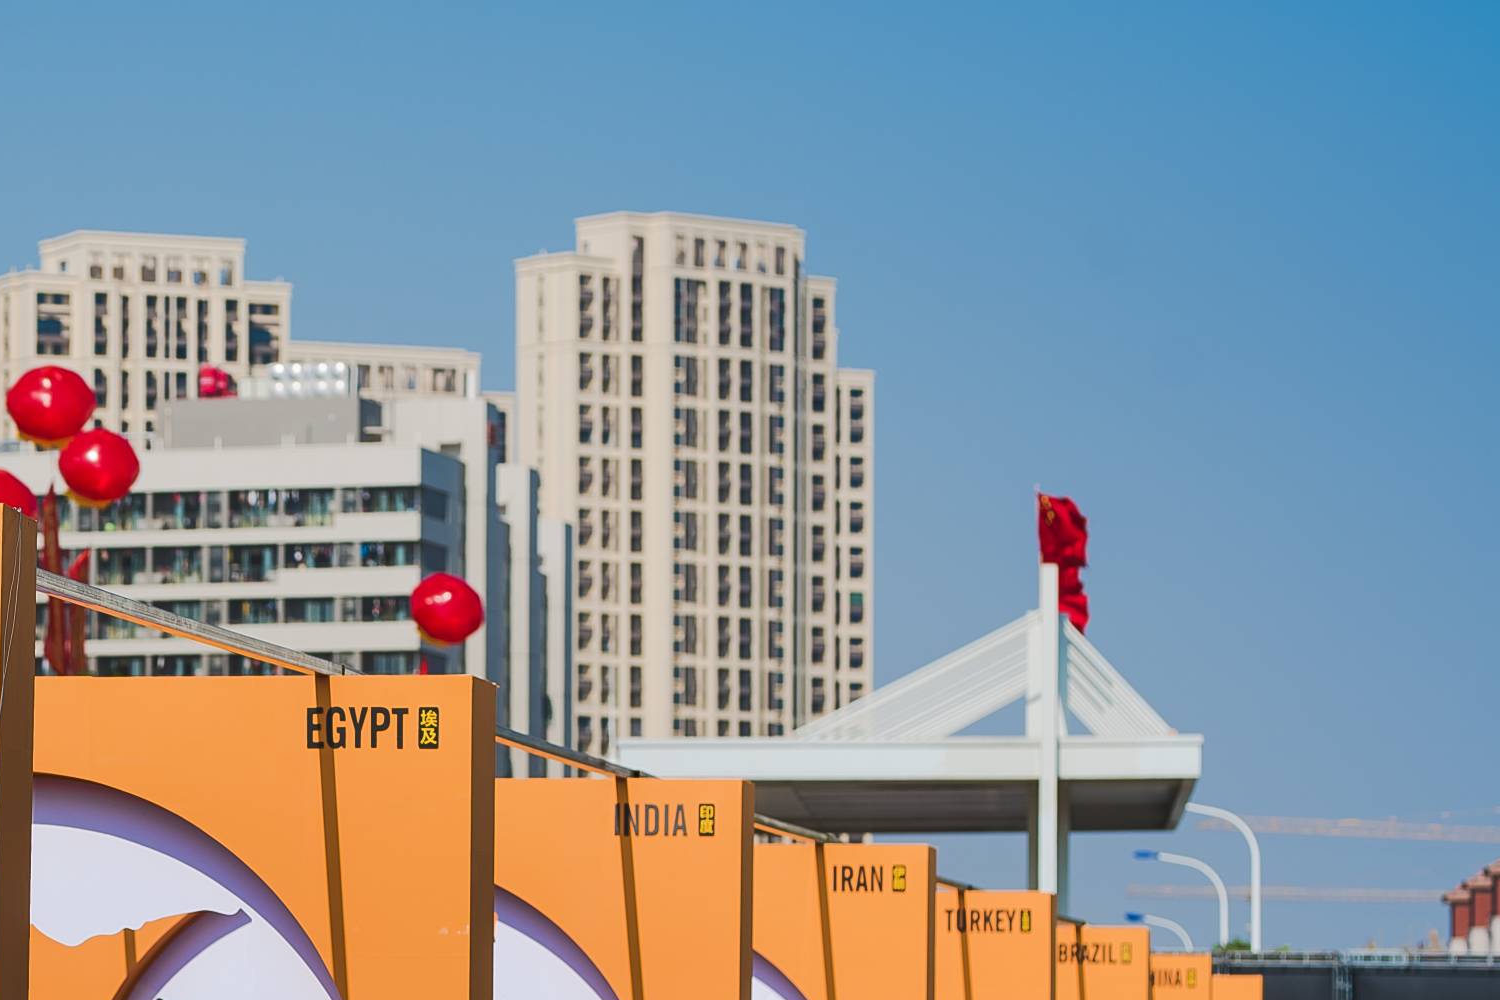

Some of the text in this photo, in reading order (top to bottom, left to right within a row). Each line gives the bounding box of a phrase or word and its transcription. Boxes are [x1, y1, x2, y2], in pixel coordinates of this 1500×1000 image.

[306, 706, 409, 749] EGYPT
[419, 709, 438, 745] 埃及
[614, 803, 688, 836] INDIA
[833, 865, 884, 892] IRAN
[945, 908, 1016, 932] TURKEY
[1058, 943, 1117, 964] BRAZIL
